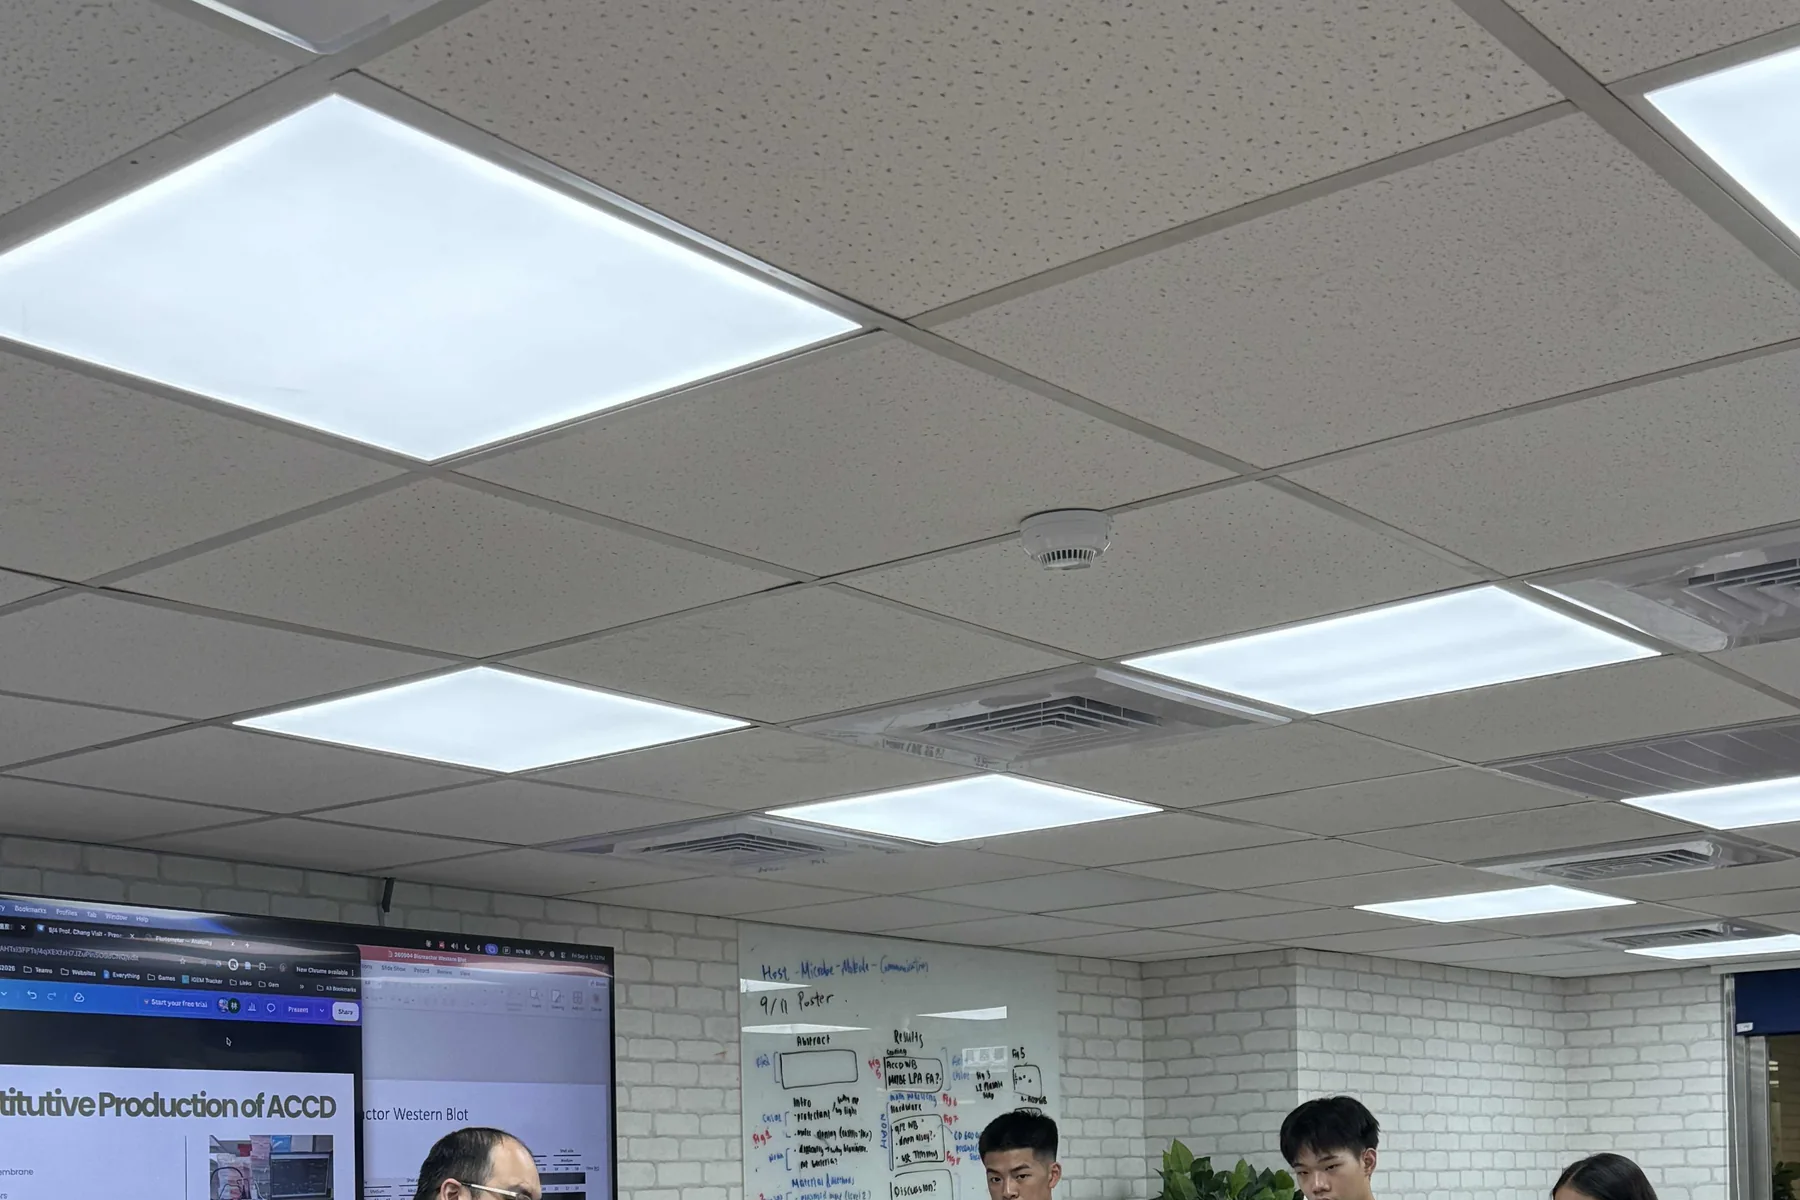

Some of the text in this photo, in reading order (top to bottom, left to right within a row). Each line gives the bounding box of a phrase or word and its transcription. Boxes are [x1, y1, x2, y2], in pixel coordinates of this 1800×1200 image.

[14, 905, 47, 914] Bookmarks
[56, 908, 78, 916] Profiles
[105, 912, 128, 920] Window
[72, 969, 96, 977] Websites
[112, 972, 141, 981] Everything
[158, 974, 176, 982] Games
[205, 977, 223, 985] Tracker
[308, 967, 326, 975] Chrome
[328, 968, 348, 976] available
[762, 964, 790, 981] Host
[801, 960, 833, 979] Microbe
[151, 999, 166, 1007] Start
[182, 1000, 194, 1008] free
[288, 1006, 309, 1014] Present
[760, 991, 835, 1016] 9/11 Poster
[338, 1008, 353, 1016] Share
[797, 1034, 830, 1047] Abstract
[894, 1030, 924, 1049] Results
[1012, 1047, 1026, 1060] Fig 5
[908, 1073, 923, 1085] LPA
[926, 1073, 940, 1085] FA?
[100, 1090, 238, 1118] Production
[242, 1092, 265, 1118] of
[267, 1095, 337, 1119] ACCD
[793, 1097, 812, 1108] Intro
[890, 1103, 922, 1114] Hardware
[393, 1108, 443, 1121] Western
[447, 1108, 469, 1122] Blot
[943, 1114, 952, 1126] Fig
[894, 1180, 937, 1198] Discussion?
